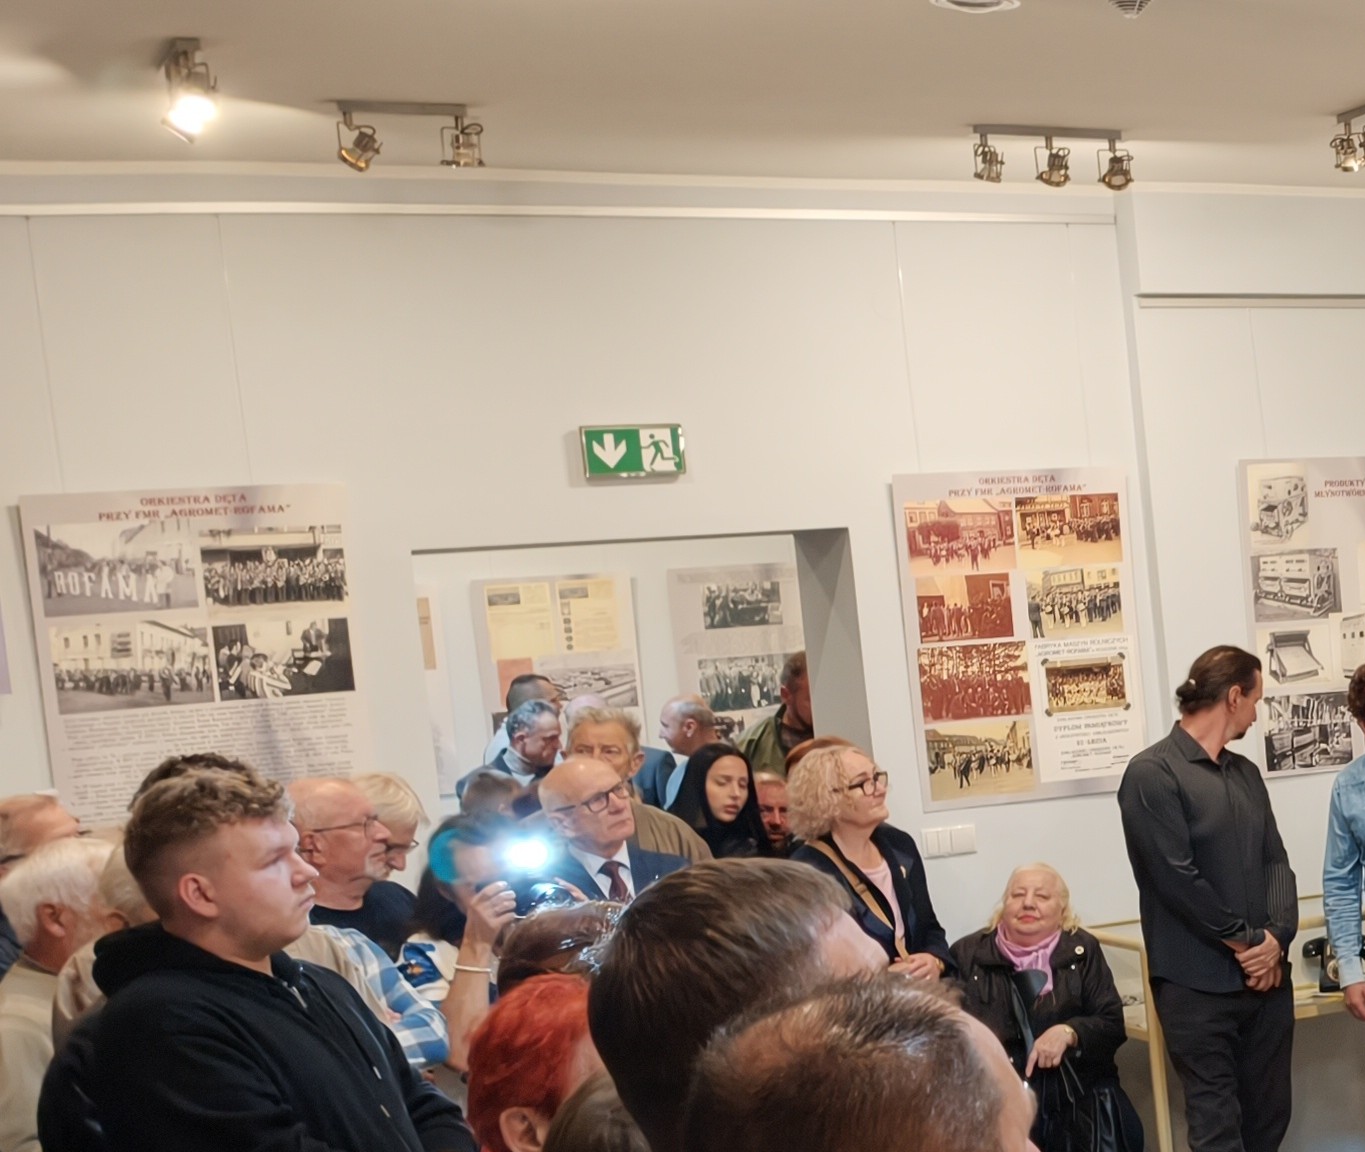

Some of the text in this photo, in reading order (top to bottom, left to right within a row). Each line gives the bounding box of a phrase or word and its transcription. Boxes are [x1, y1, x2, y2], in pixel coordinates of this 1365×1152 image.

[978, 474, 1056, 485] ORKIESTRA DĘTA
[1324, 477, 1365, 487] PRODUKTY
[948, 487, 972, 497] PRZY
[975, 487, 993, 496] FMR
[140, 493, 247, 507] ORKIESTRA DĘTA
[98, 510, 132, 522] PRZY
[135, 510, 160, 520] FMR
[54, 565, 159, 603] ROFAMA
